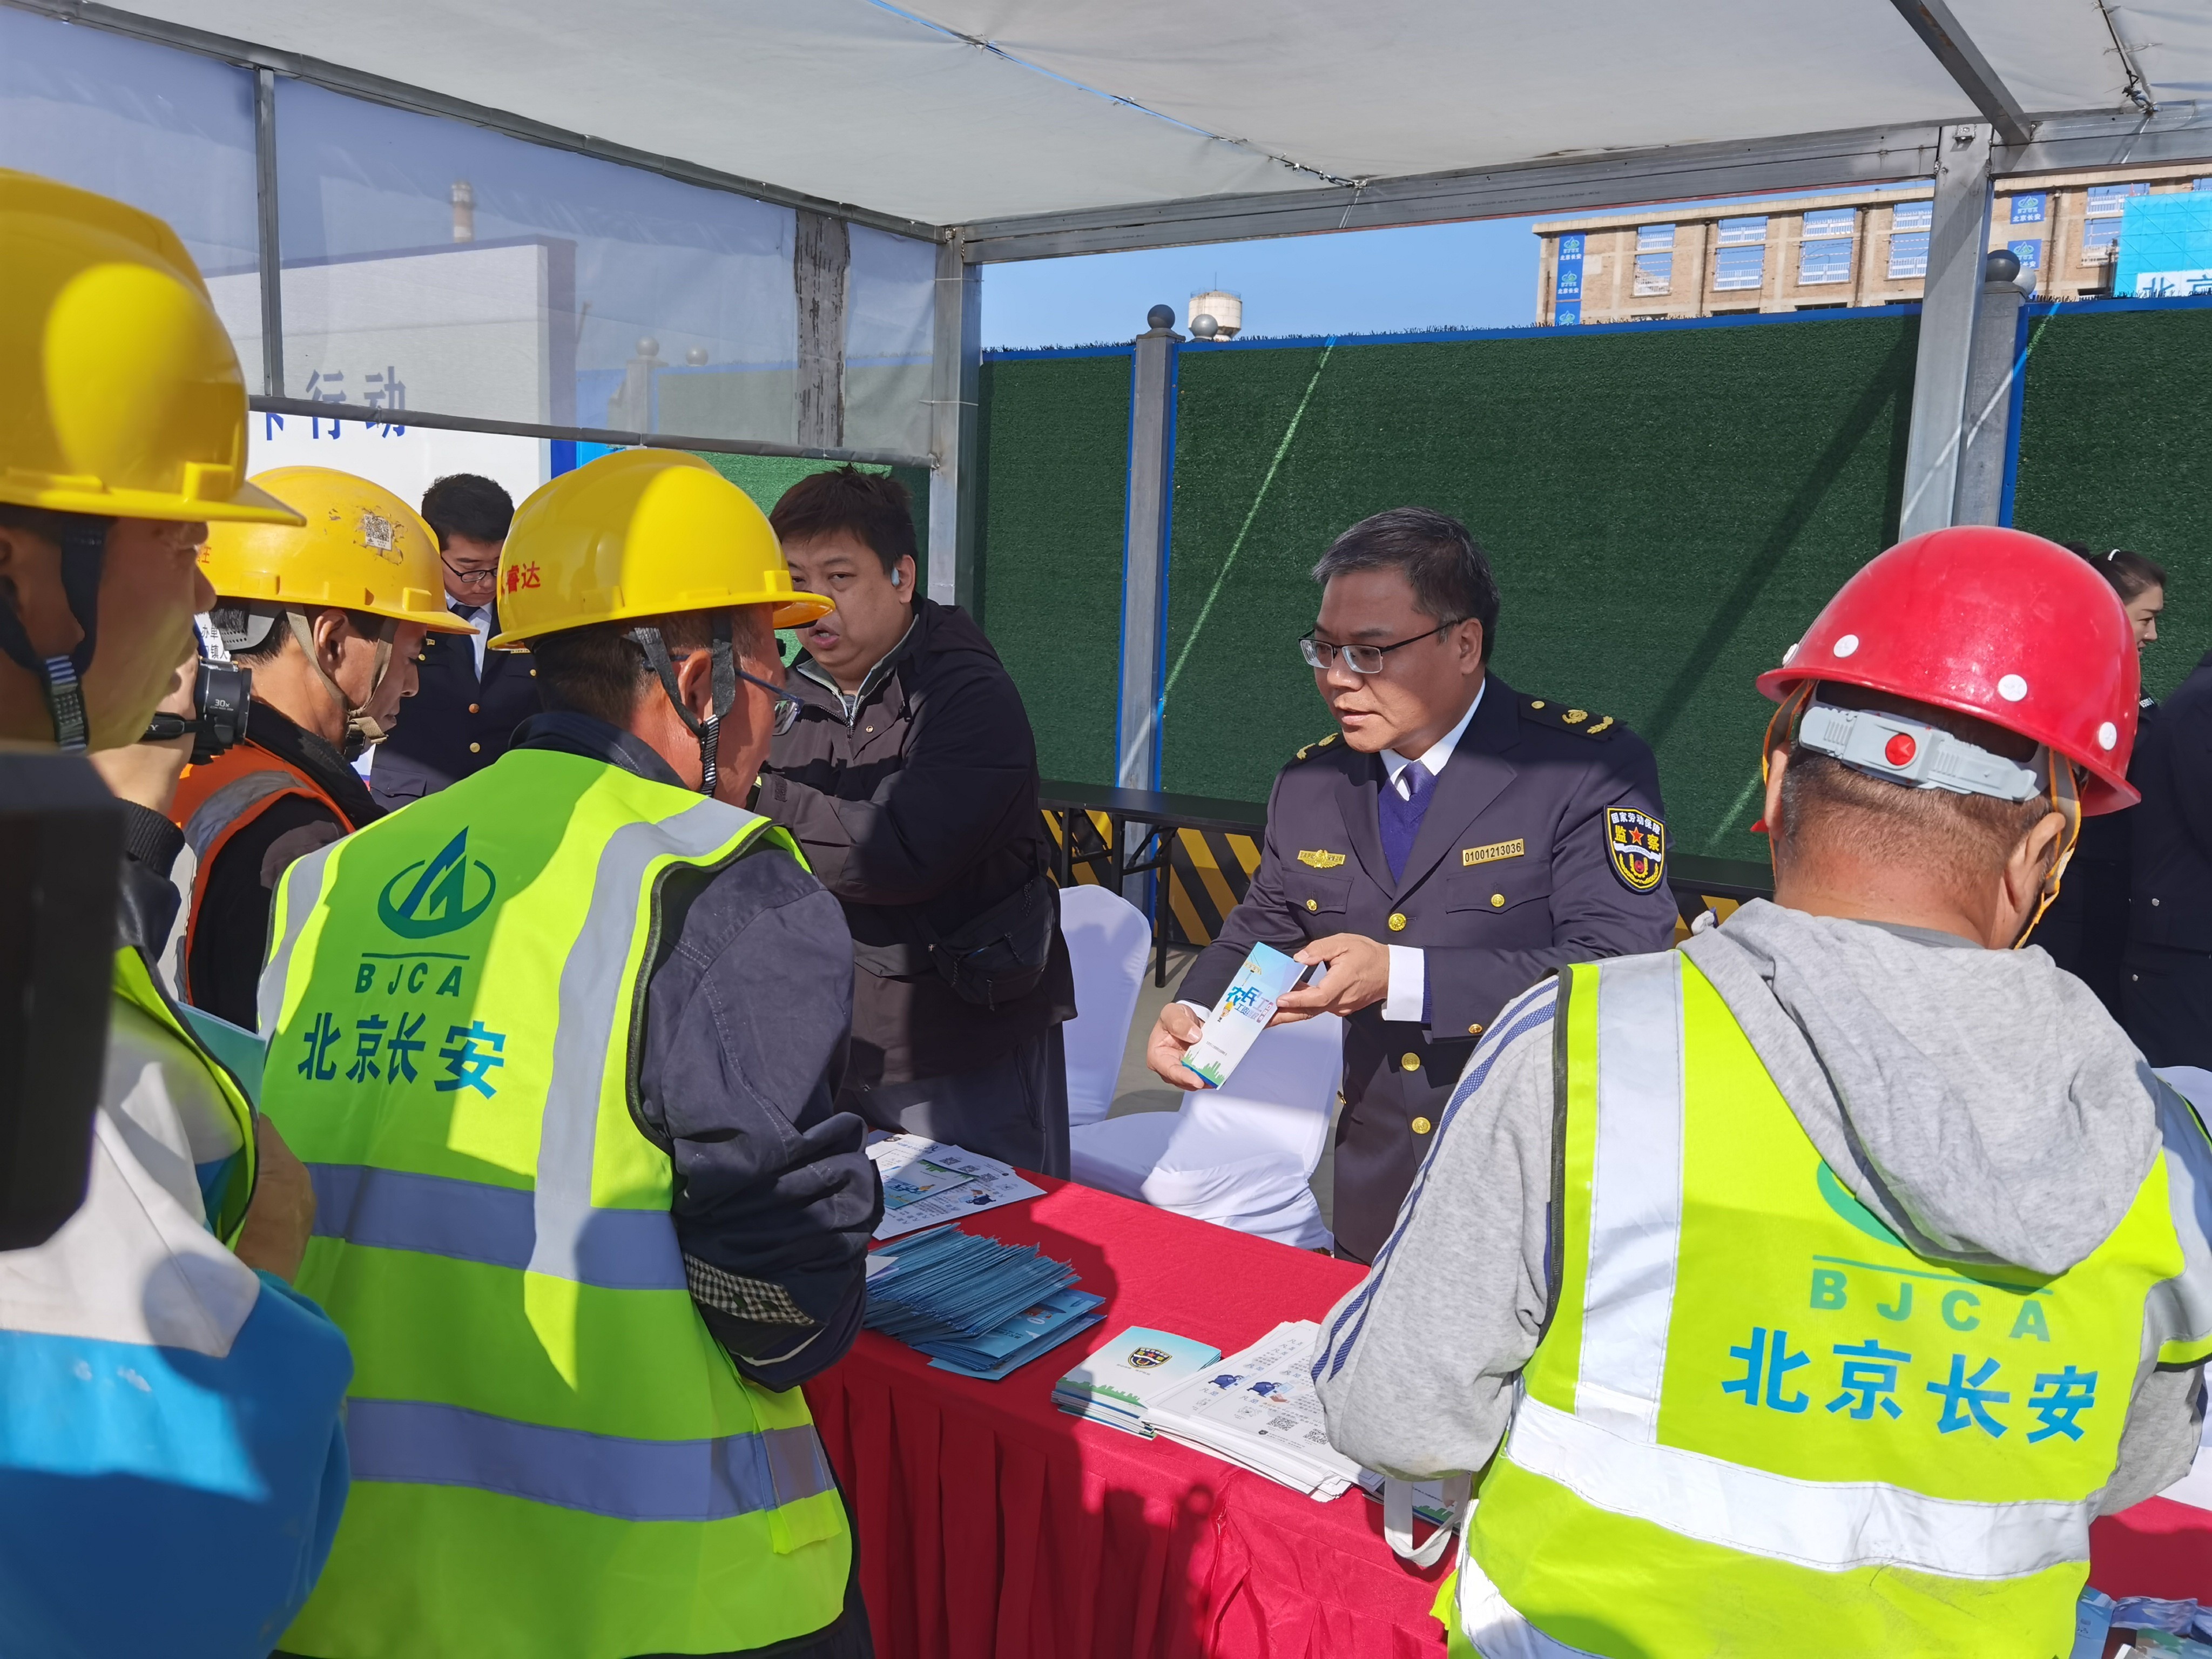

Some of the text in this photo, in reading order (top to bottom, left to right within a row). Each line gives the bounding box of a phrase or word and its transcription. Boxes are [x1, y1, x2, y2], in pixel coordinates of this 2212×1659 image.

[2013, 214, 2041, 222] 北京长安
[501, 561, 541, 596] 睿达
[1611, 812, 1661, 835] 国家劳动保障
[1465, 842, 1522, 863] 01001213036
[355, 962, 463, 997] BJCA
[1225, 986, 1270, 1013] 农民工
[298, 1011, 507, 1100] 北京长安
[1809, 1269, 2051, 1343] BJCA
[1721, 1326, 2099, 1444] 北京长安
